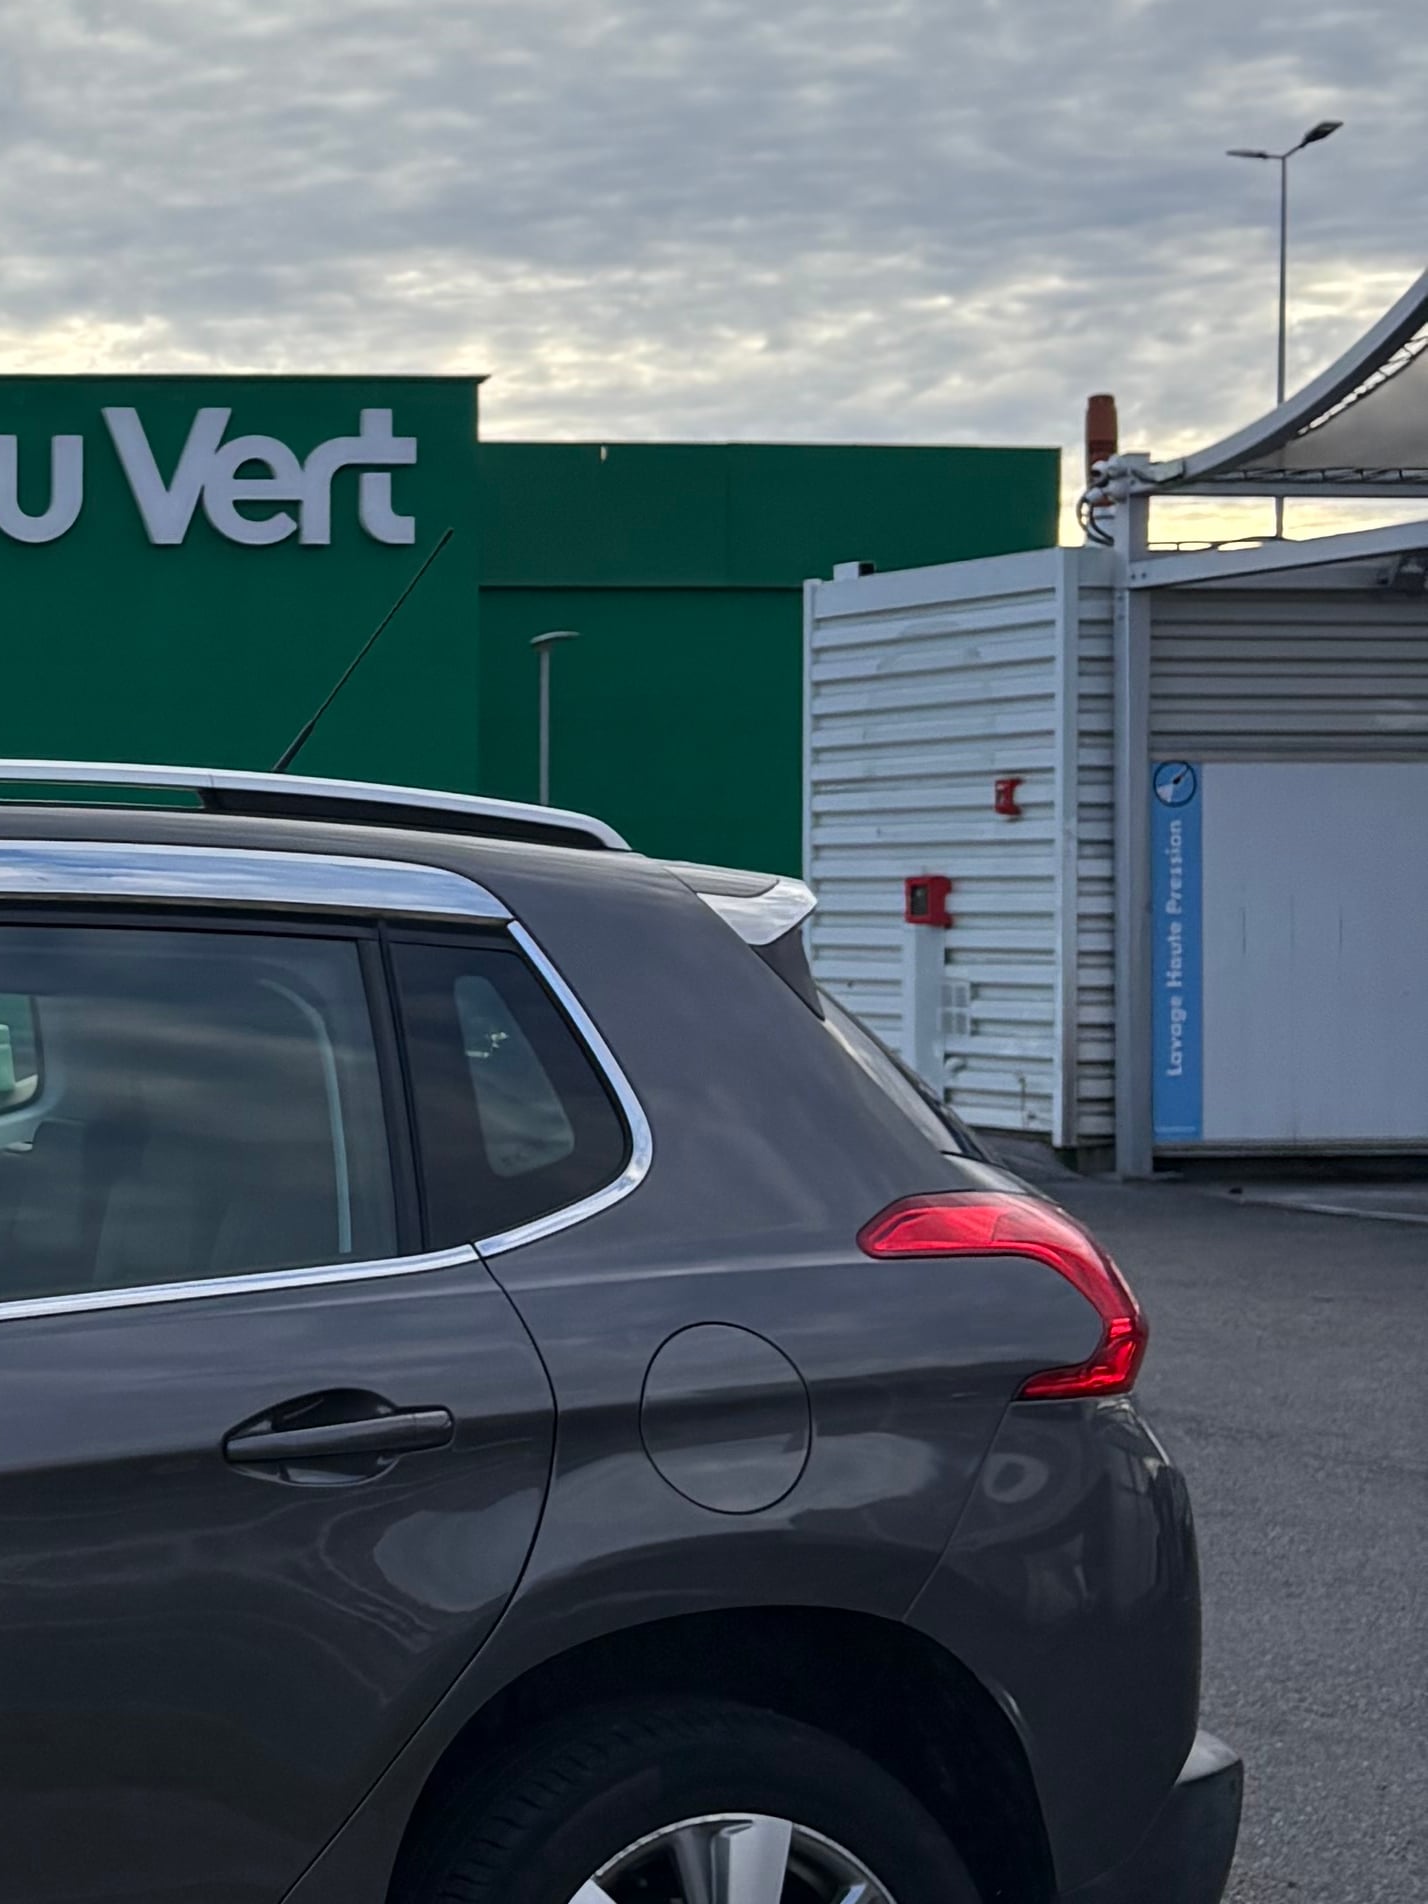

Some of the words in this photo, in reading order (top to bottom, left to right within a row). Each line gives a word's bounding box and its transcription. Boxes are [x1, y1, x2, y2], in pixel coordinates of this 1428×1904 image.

[101, 406, 417, 546] Vert
[1164, 819, 1183, 915] Pression
[1165, 921, 1183, 988] Haute
[1165, 995, 1187, 1077] Lavage
